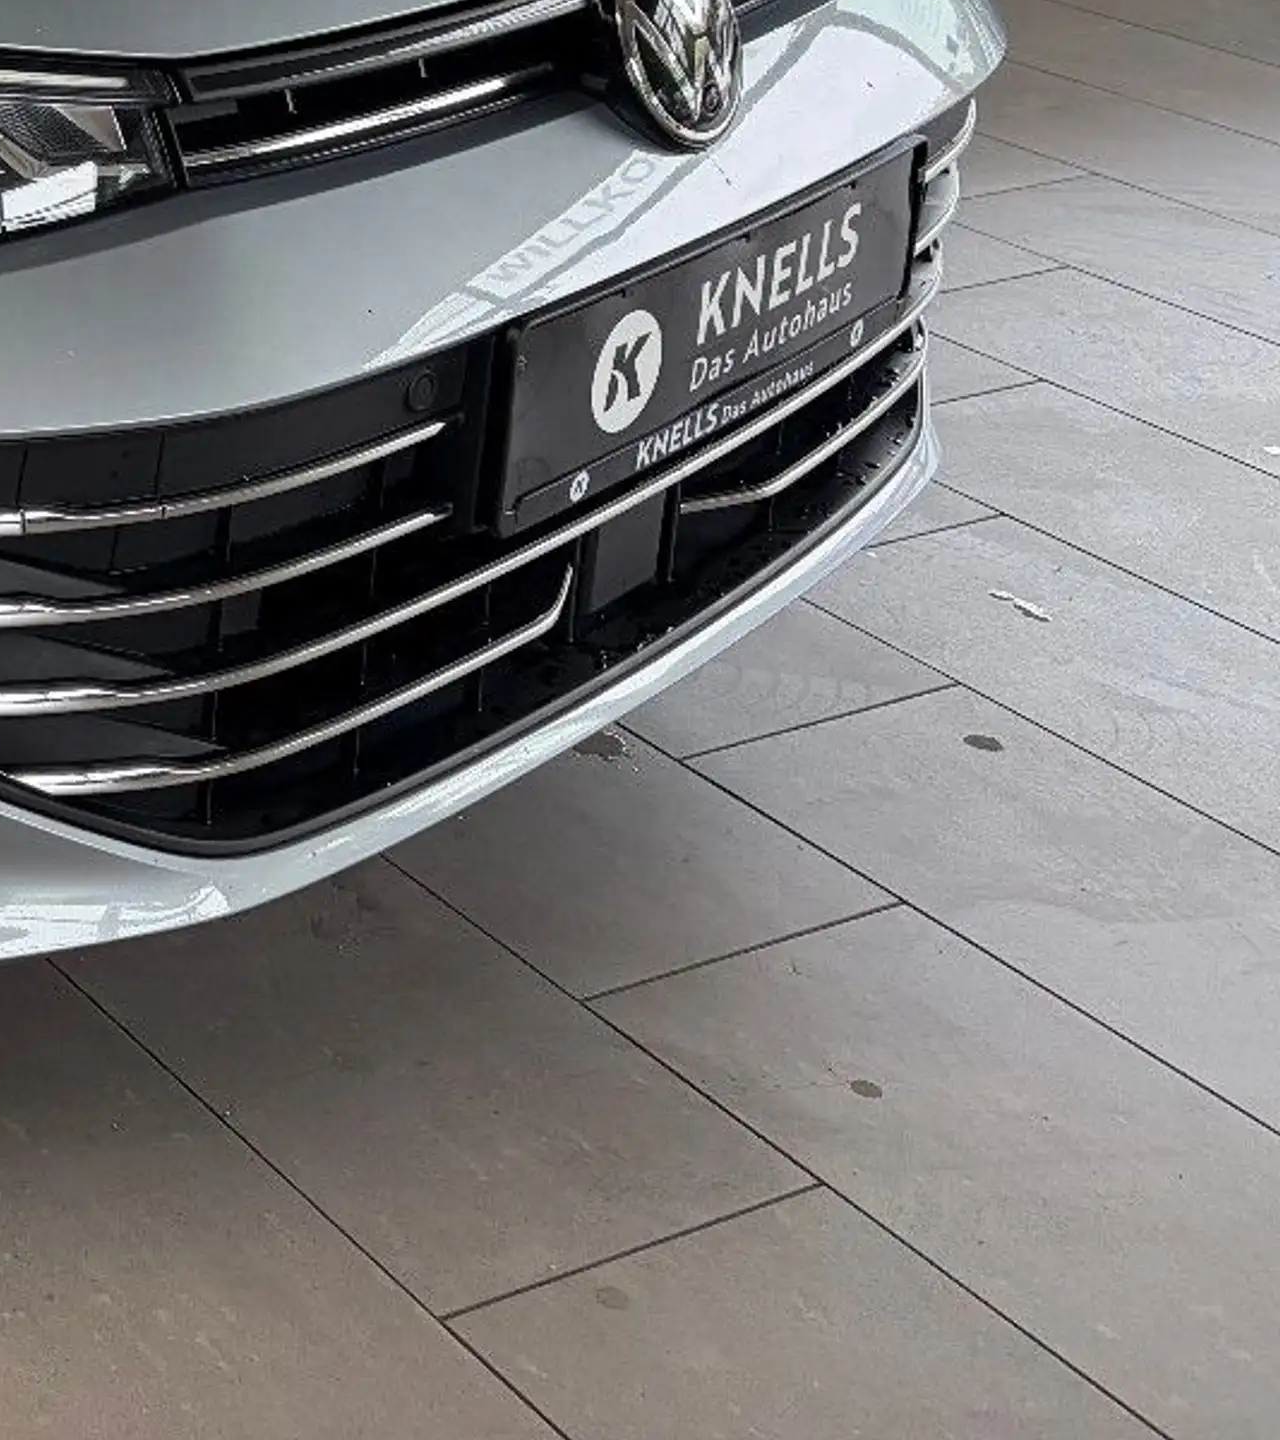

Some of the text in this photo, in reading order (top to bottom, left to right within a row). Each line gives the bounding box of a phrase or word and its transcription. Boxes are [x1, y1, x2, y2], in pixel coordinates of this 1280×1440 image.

[696, 202, 862, 347] KNELLS
[689, 348, 736, 392] Das
[742, 282, 852, 364] Autohaus
[635, 361, 814, 470] KNELLS Das Autohaus
